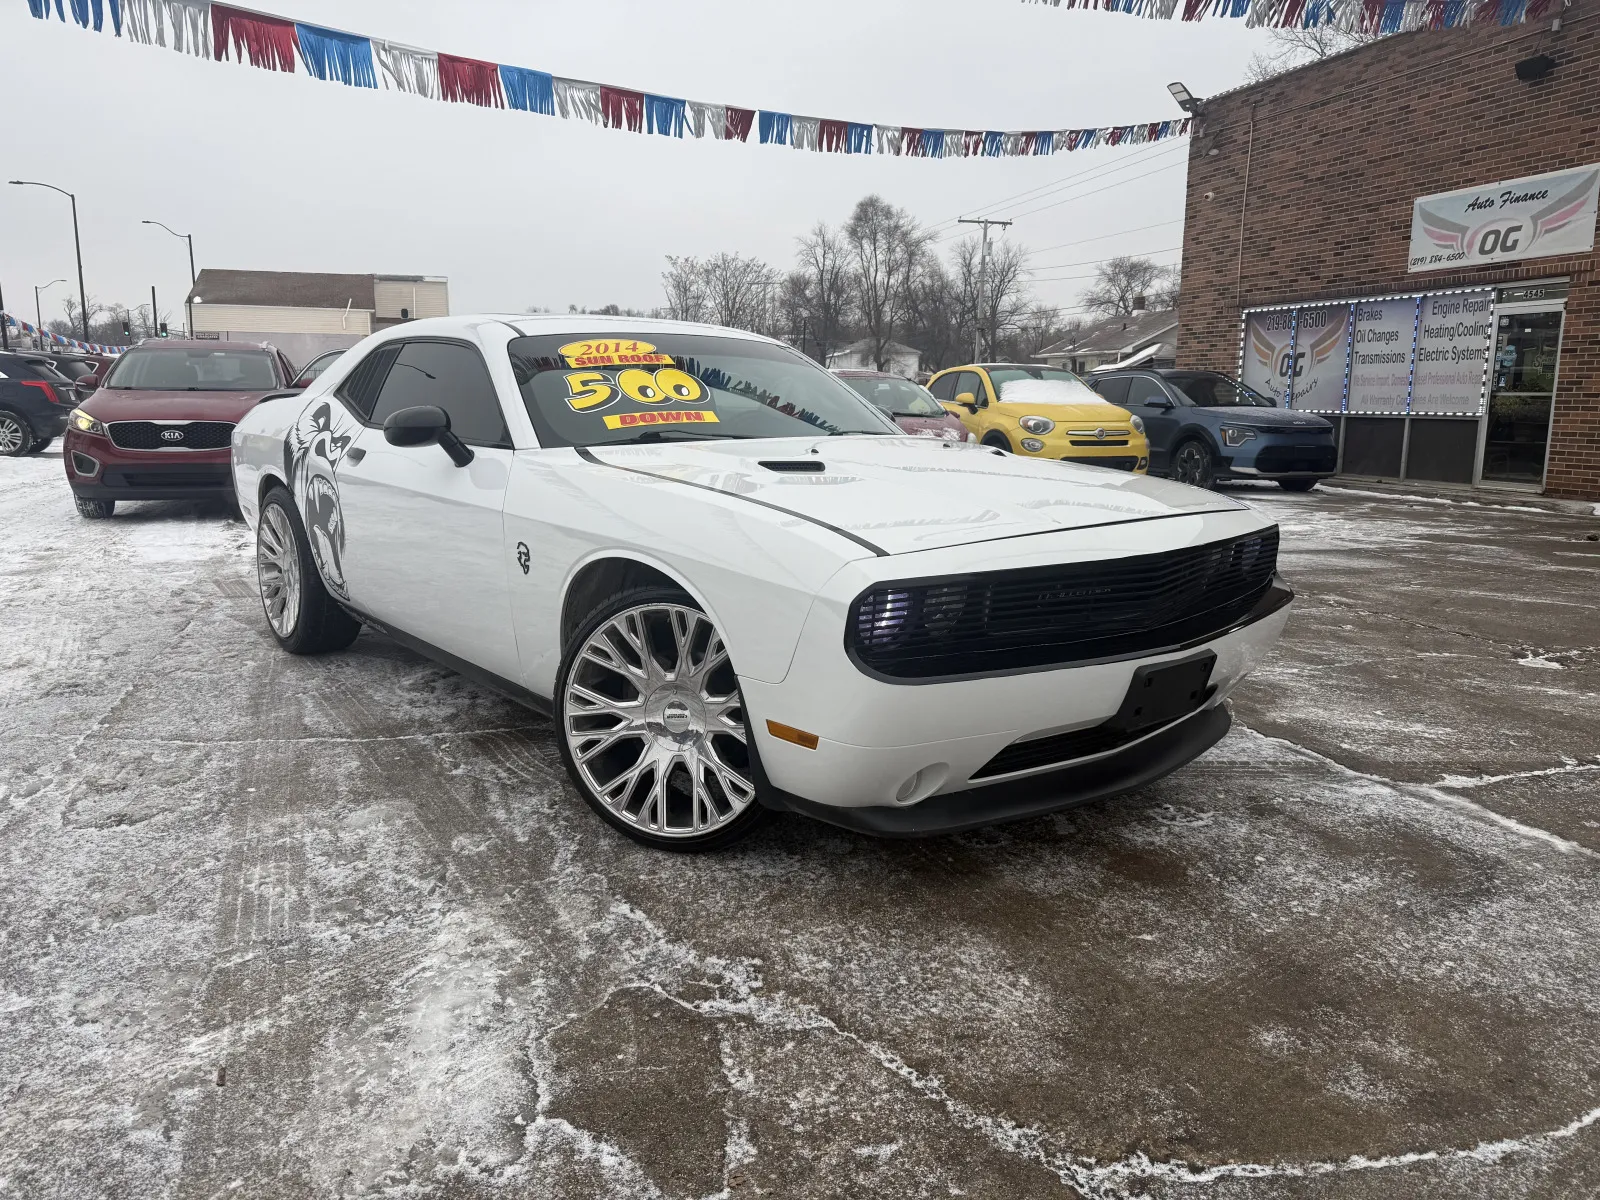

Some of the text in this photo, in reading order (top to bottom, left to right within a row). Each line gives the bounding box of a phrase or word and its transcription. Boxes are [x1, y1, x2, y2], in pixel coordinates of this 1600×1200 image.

[1464, 188, 1549, 213] Auto Finance
[1478, 224, 1523, 255] OG
[1410, 251, 1465, 266] (219) 884-6500
[1523, 289, 1545, 299] 4545
[1357, 308, 1383, 322] Brakes
[1432, 296, 1491, 318] Engine Repair
[1266, 310, 1327, 332] 219-88-6500
[1356, 328, 1399, 346] Oil Changes
[1423, 321, 1489, 342] Heating/Cooling
[580, 341, 639, 356] 2014
[1418, 346, 1450, 362] Electric
[1450, 345, 1488, 365] Systems
[575, 354, 666, 366] SUN ROOF
[1354, 350, 1406, 365] Transmissions
[1428, 371, 1456, 386] Professional
[563, 368, 711, 413] 500
[1265, 378, 1282, 398] Auto
[1440, 393, 1470, 405] Welcome
[619, 411, 705, 427] DOWN
